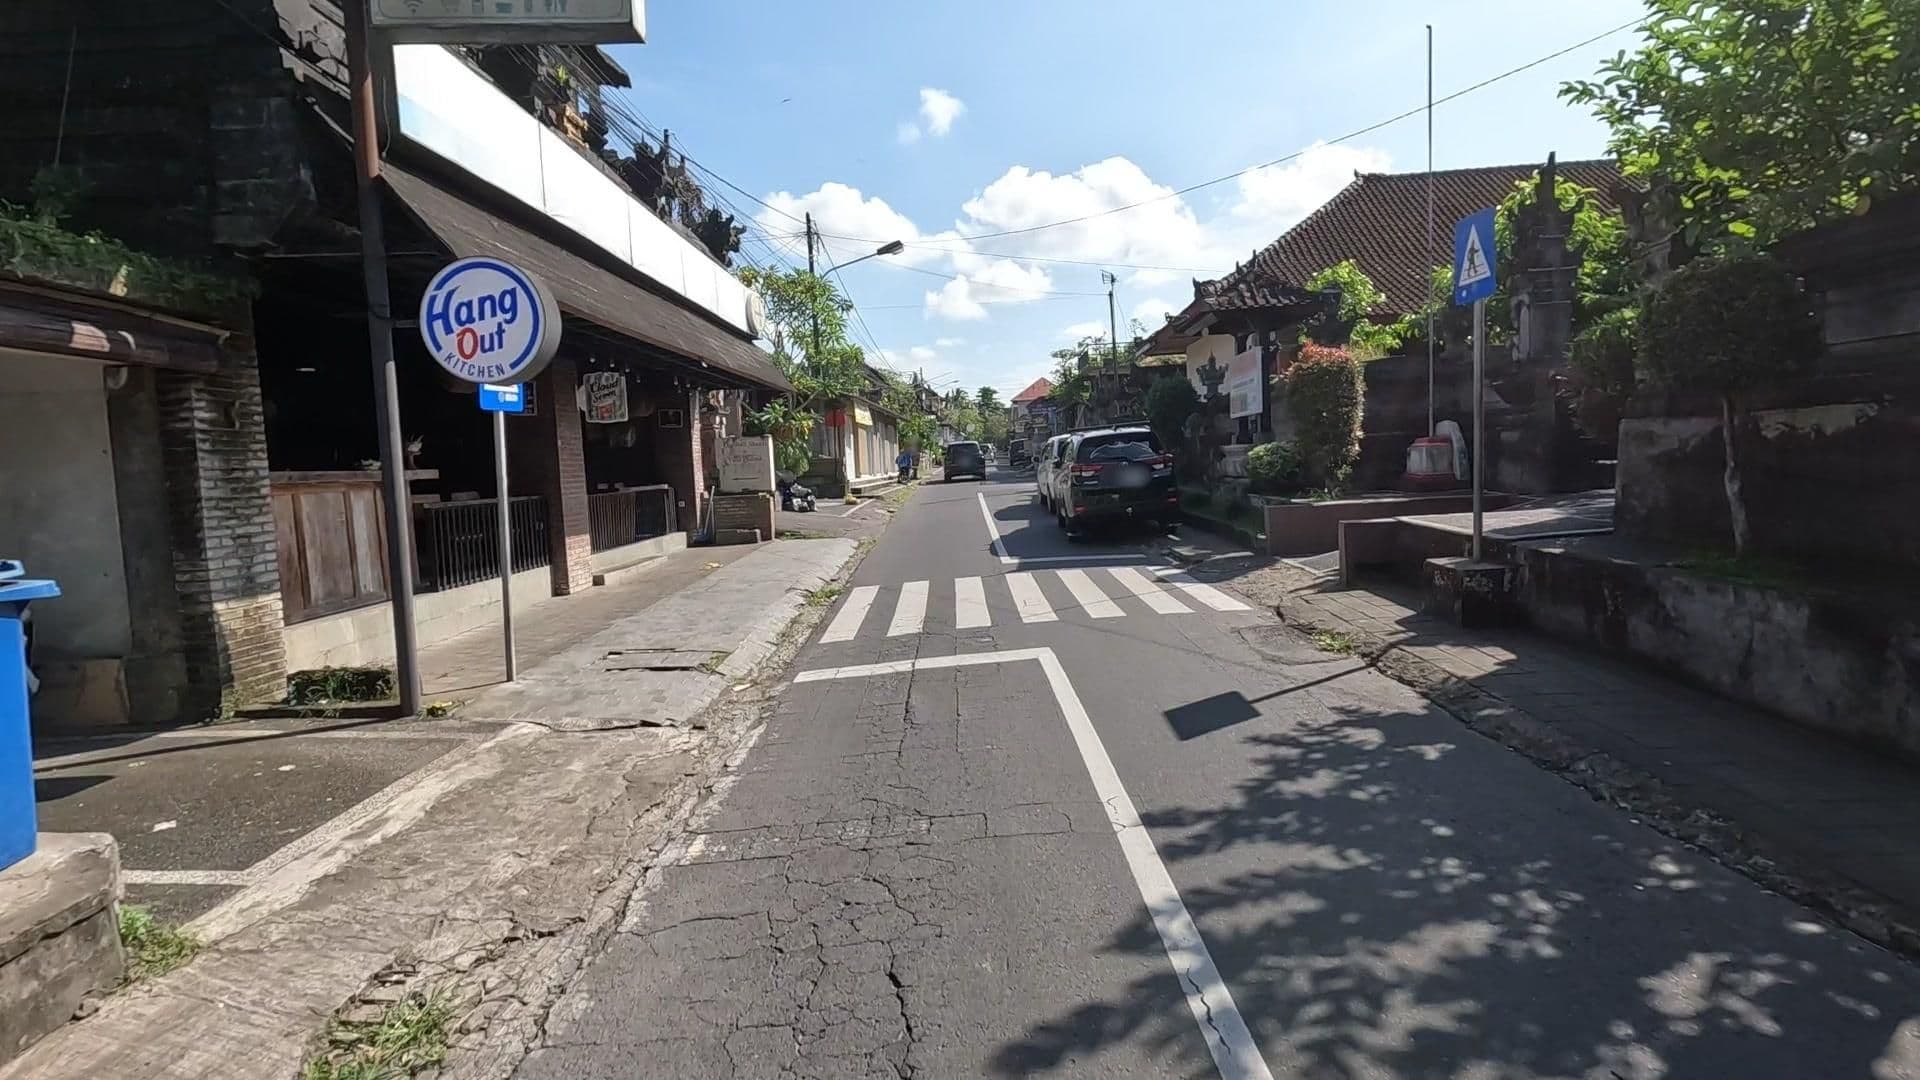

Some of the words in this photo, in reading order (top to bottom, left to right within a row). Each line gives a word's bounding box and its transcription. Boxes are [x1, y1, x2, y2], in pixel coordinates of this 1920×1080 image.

[427, 285, 518, 335] Hang
[456, 321, 505, 360] Out
[444, 352, 506, 378] KITCHEN
